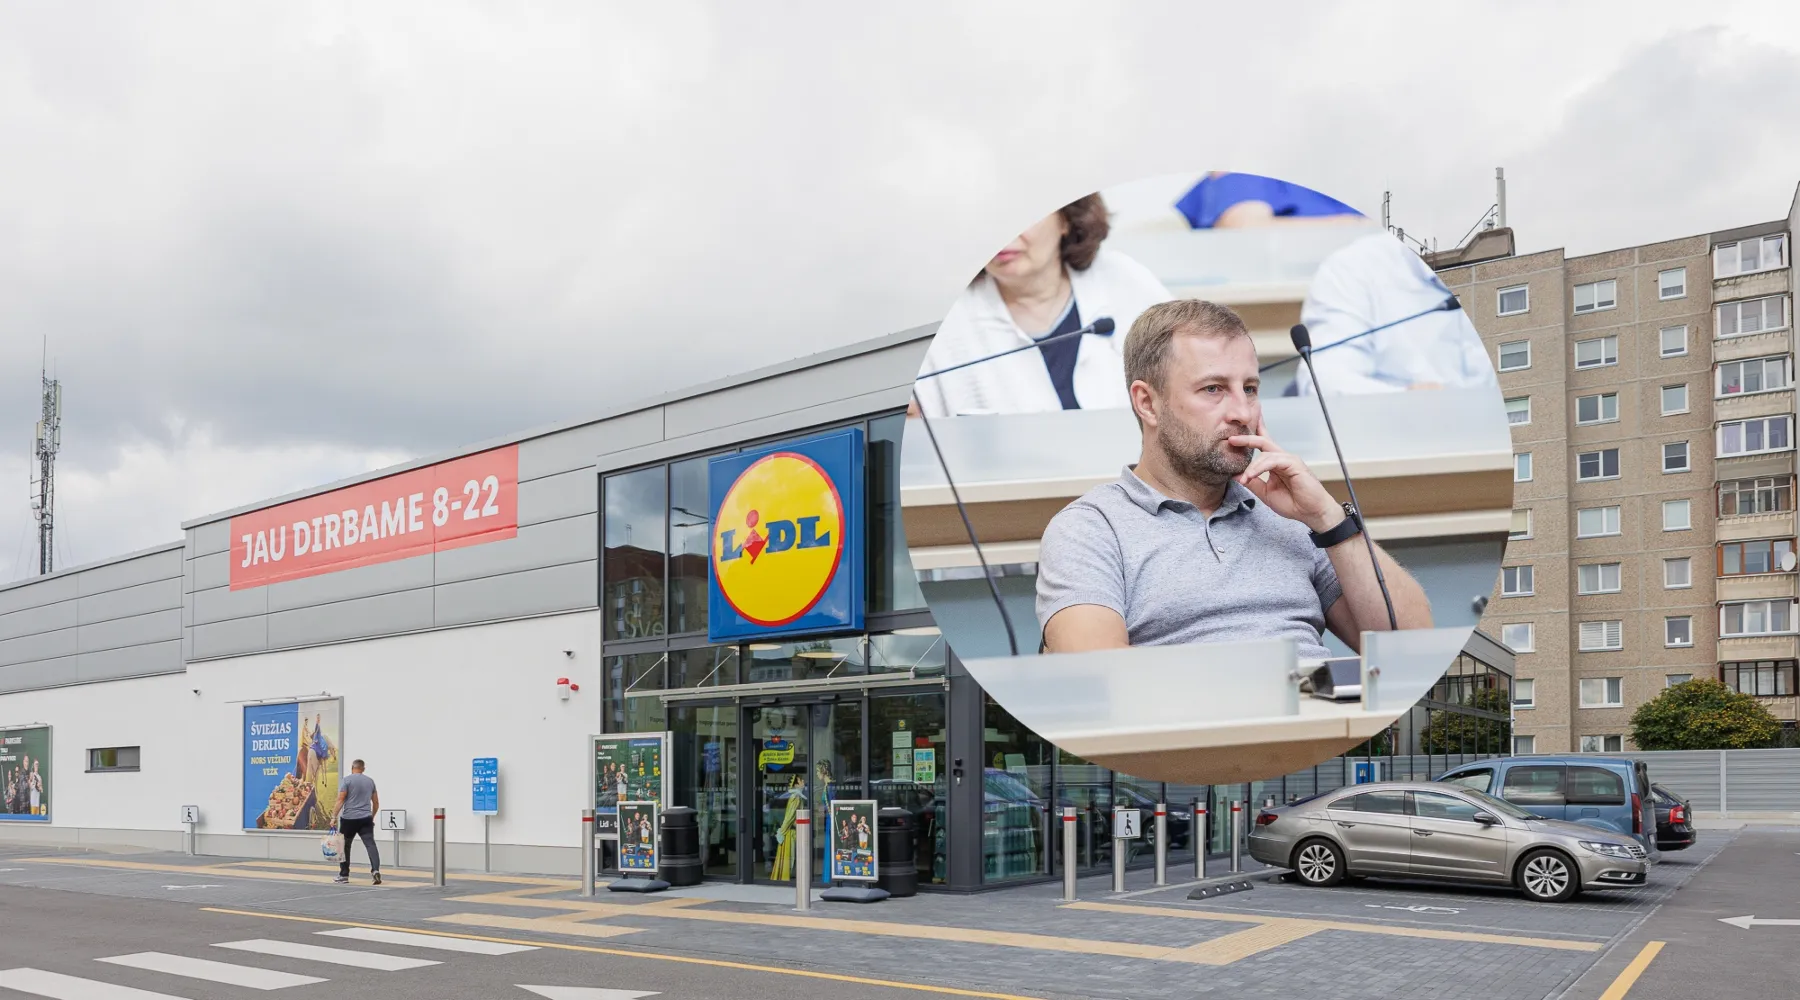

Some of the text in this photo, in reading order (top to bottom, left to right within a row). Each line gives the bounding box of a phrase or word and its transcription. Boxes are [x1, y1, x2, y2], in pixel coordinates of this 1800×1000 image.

[241, 475, 500, 568] JAU DIRBAME 8-22
[720, 509, 830, 565] LIDL
[251, 720, 292, 736] ŠVIEŽIAS
[252, 738, 290, 751] DERLIUS
[251, 754, 291, 765] NORS VEŽIMU
